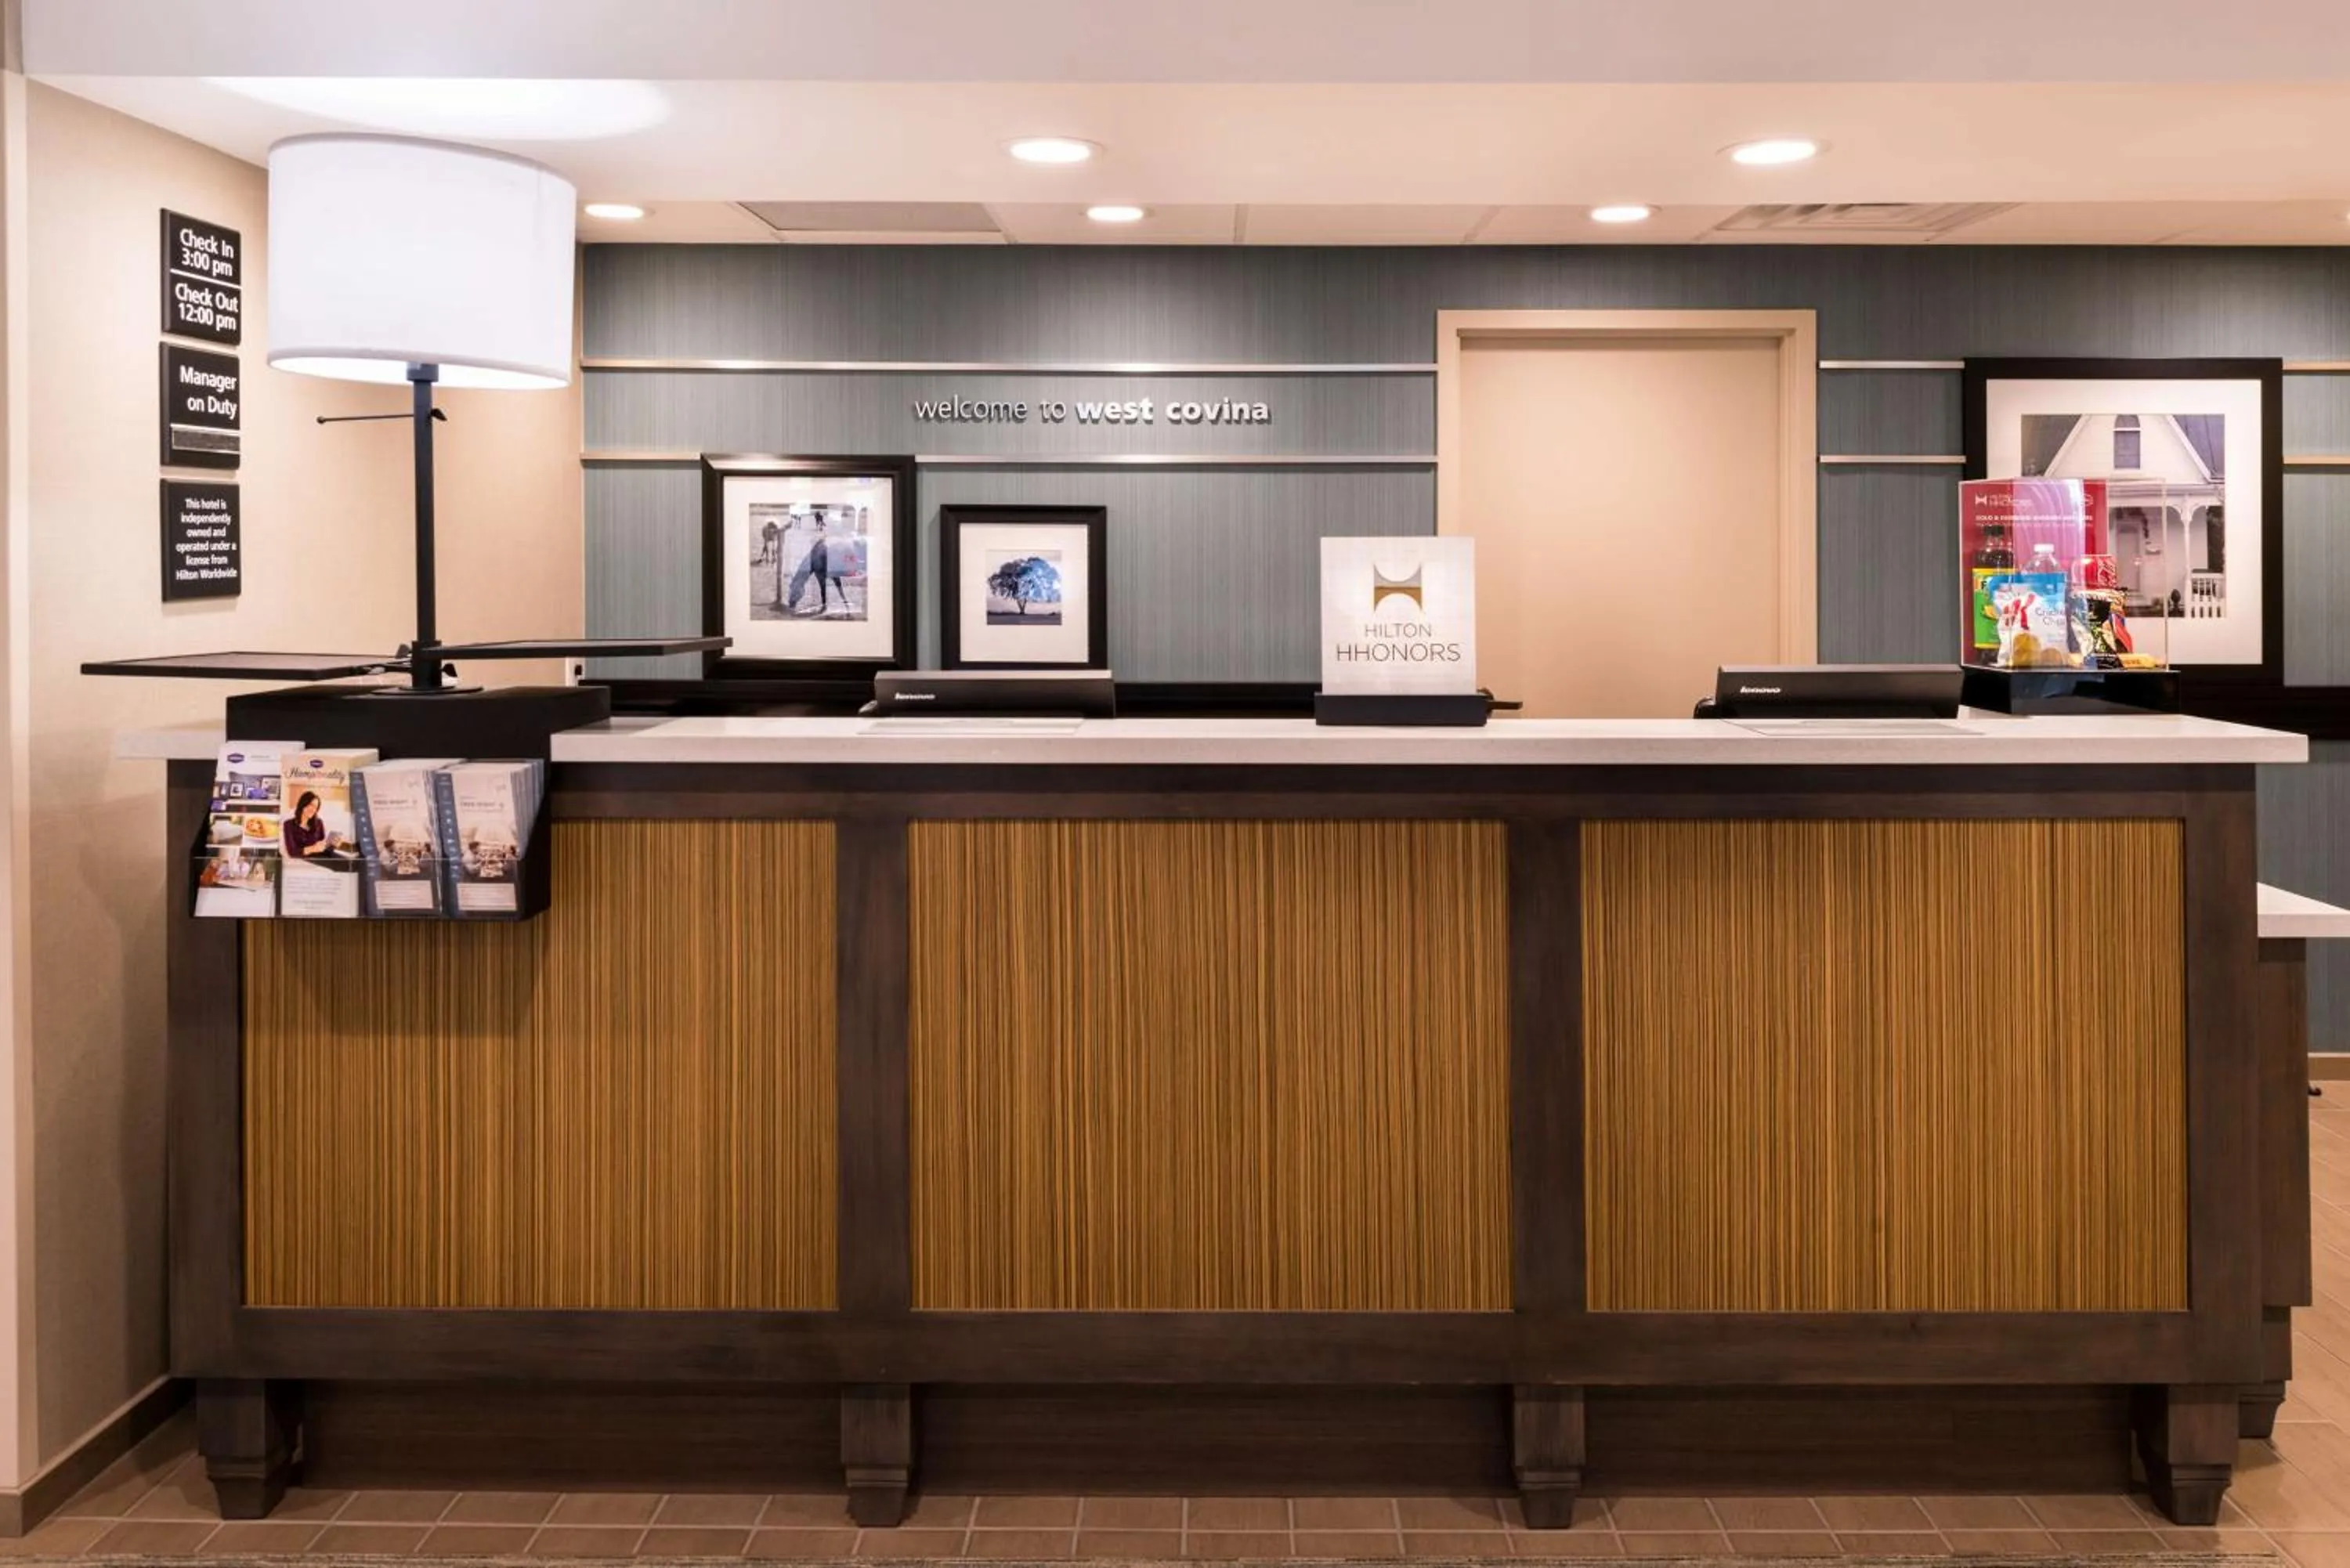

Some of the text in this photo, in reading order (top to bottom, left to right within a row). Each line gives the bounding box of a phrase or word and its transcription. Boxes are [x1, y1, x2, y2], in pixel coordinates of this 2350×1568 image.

[179, 229, 234, 258] Check In
[181, 248, 233, 276] 3:00 pm
[175, 283, 238, 313] Check Out
[179, 303, 237, 331] 12:00 pm
[179, 365, 237, 393] Manager
[186, 396, 237, 420] on Duty
[914, 395, 1270, 421] welcome to west covina
[185, 498, 227, 510] This hotel is
[181, 512, 231, 526] independently
[186, 526, 226, 537] owned and
[175, 540, 237, 554] operated under a
[186, 554, 228, 565] license from
[175, 567, 237, 580] Hilton Worldwide
[1365, 623, 1432, 638] HILTON
[1336, 643, 1461, 662] HHONORS
